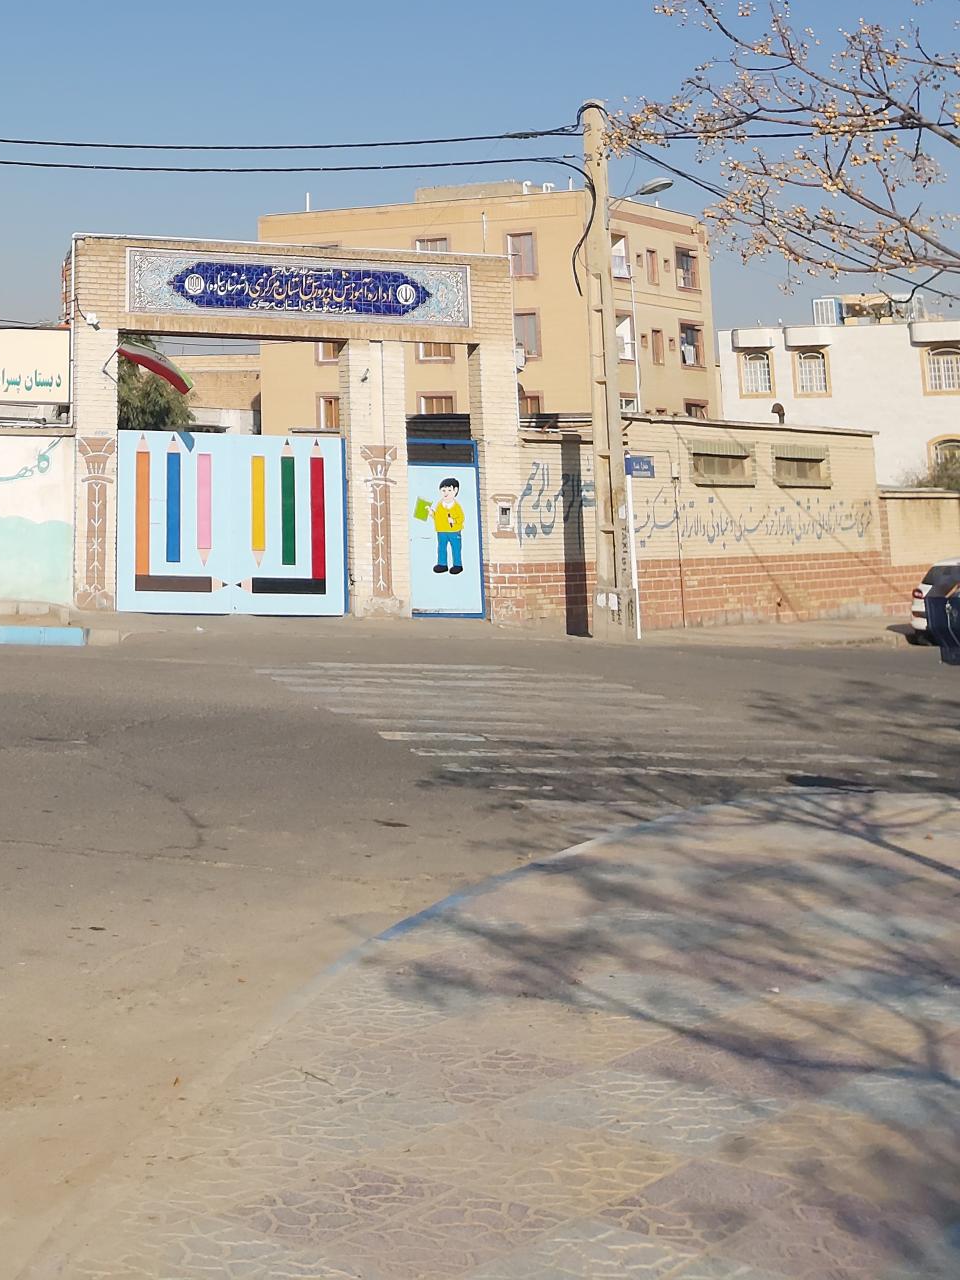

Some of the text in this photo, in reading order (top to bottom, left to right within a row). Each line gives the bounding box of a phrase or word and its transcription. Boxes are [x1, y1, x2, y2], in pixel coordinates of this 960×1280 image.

[249, 273, 279, 298] مرکزی
[273, 274, 305, 300] استان
[332, 271, 374, 302] آموزش
[249, 299, 274, 310] مرکزی
[274, 299, 301, 310] استان
[24, 368, 62, 392] دبستان
[621, 525, 629, 553] TAXI
